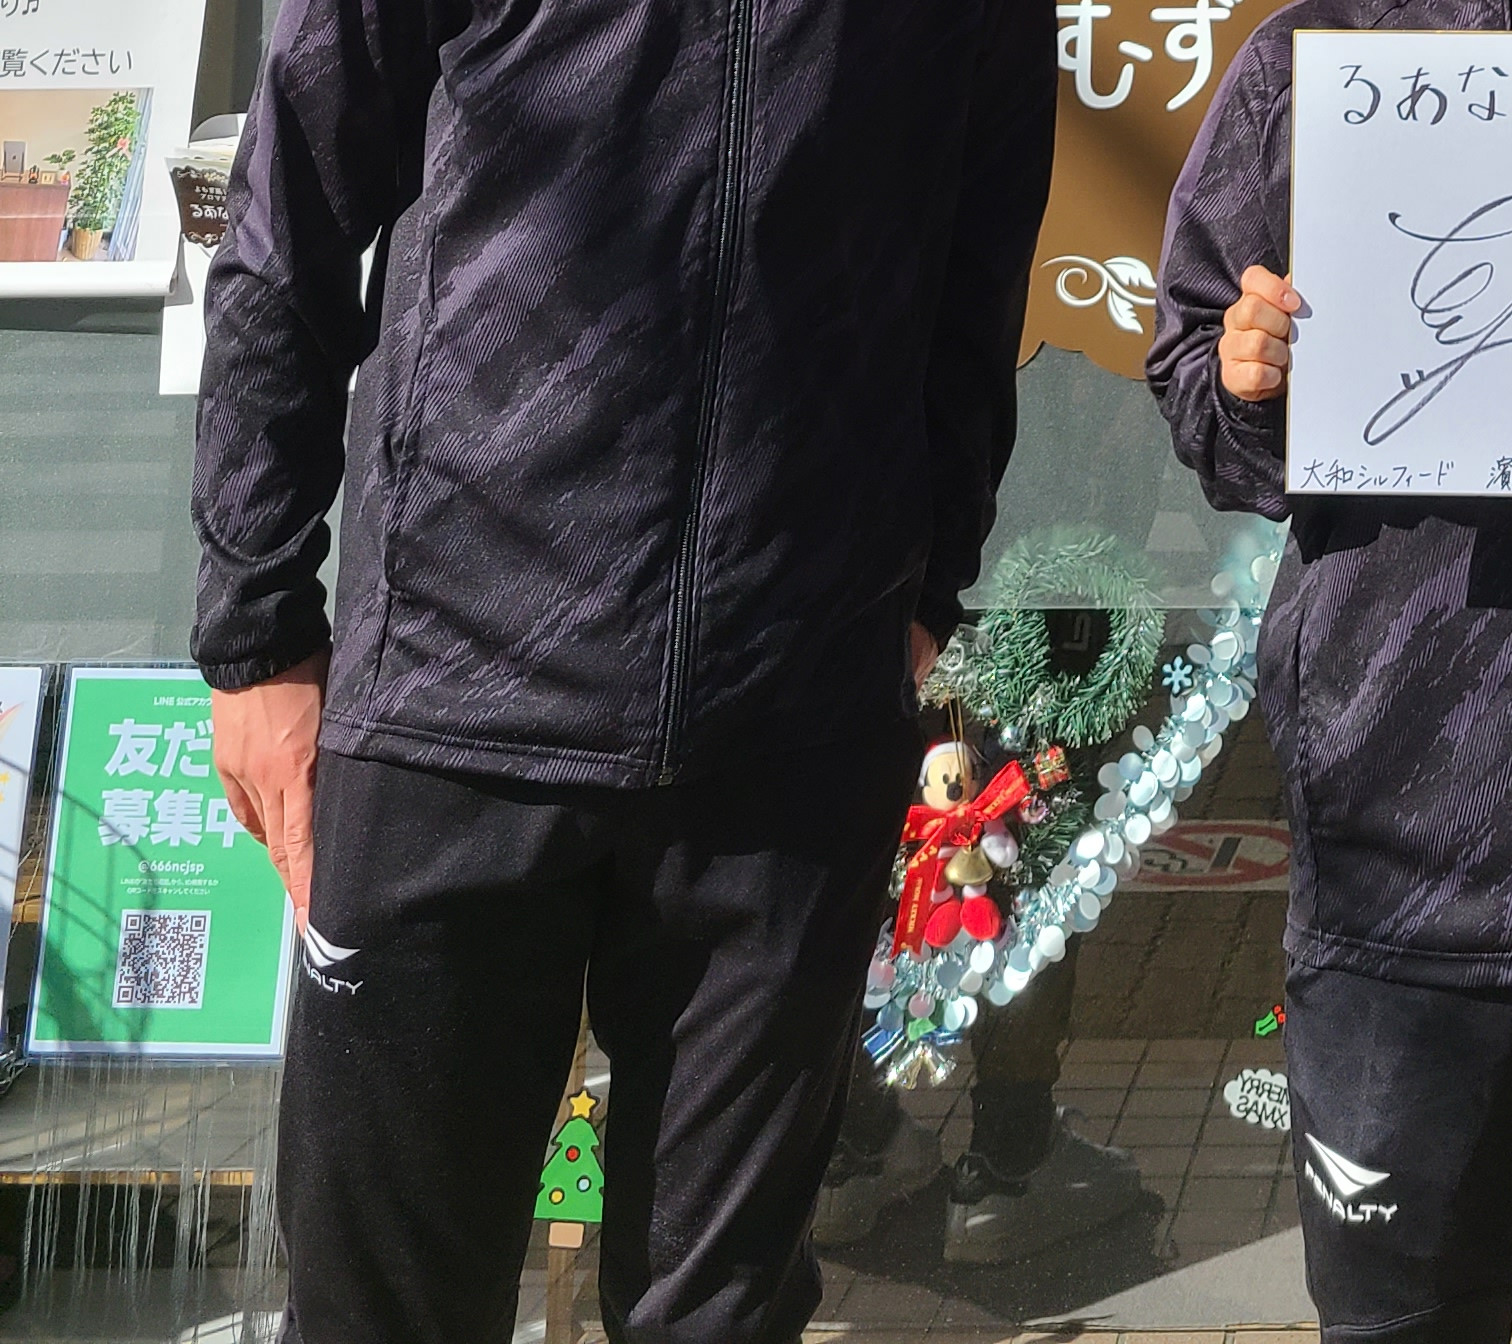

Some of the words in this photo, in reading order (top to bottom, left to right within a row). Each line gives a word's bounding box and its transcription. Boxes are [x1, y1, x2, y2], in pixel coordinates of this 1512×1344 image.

[1301, 458, 1455, 491] 大和シルフィード
[153, 696, 175, 706] LINE
[98, 788, 249, 848] 募集中
[1305, 1159, 1398, 1222] PENALTY
